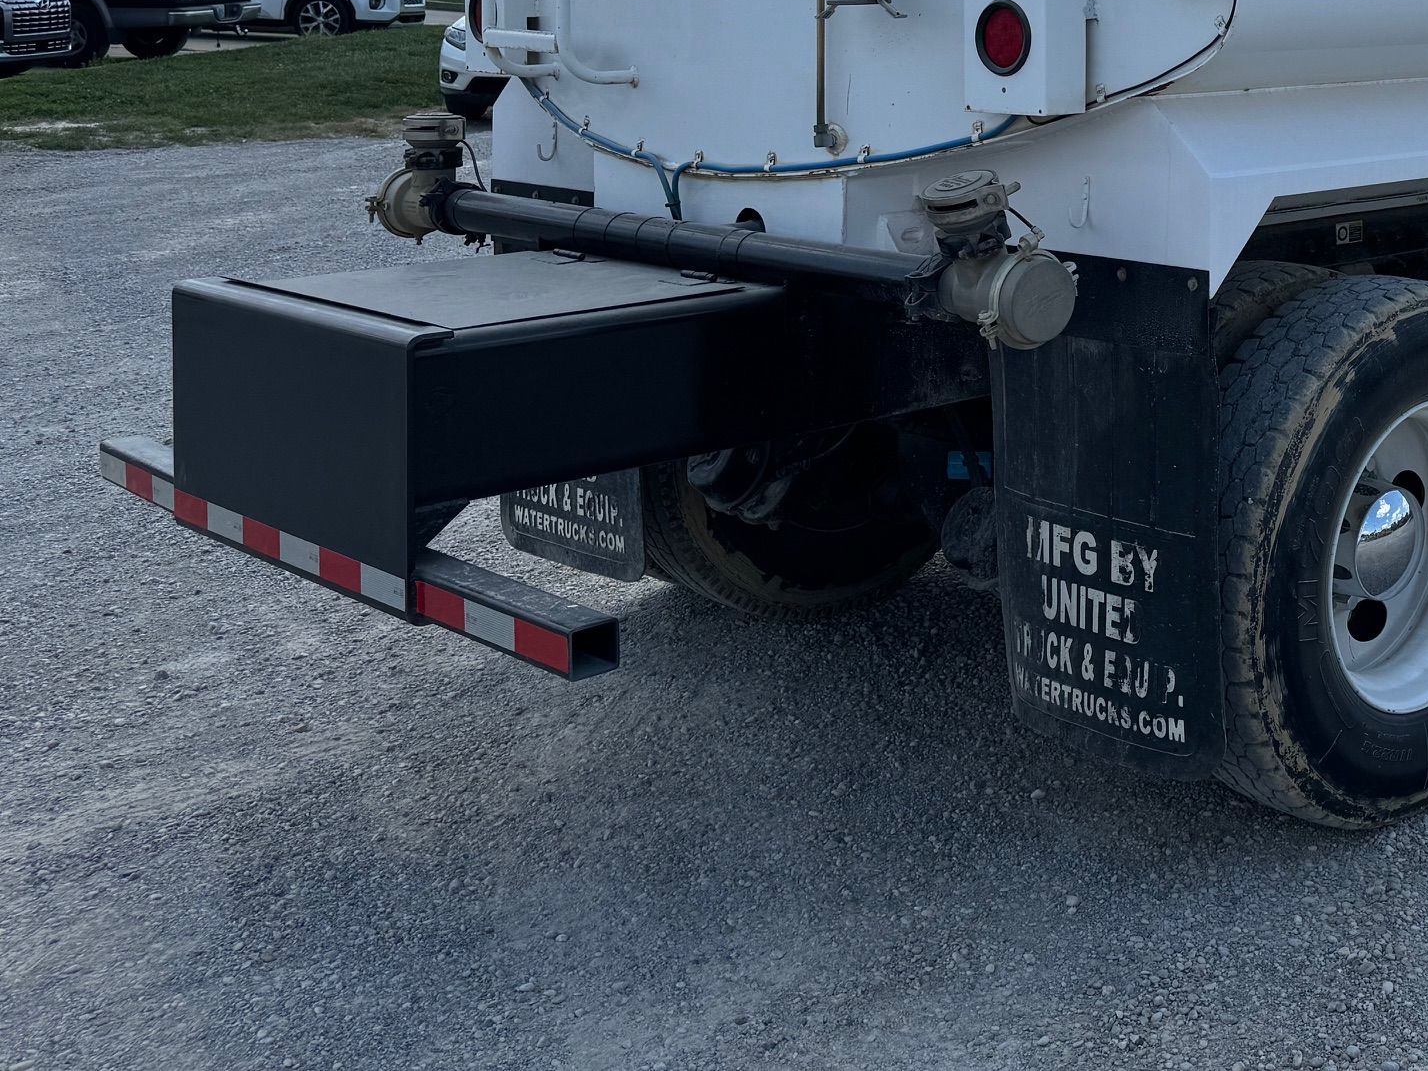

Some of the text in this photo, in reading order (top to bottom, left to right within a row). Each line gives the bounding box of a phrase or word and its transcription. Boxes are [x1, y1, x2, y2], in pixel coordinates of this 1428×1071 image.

[514, 504, 625, 554] WATERTRUCKS.COM
[516, 483, 623, 527] UCK & EQUIP.
[1026, 514, 1158, 593] MFG BY
[1081, 643, 1095, 682] &
[1104, 649, 1184, 707] EQUP.
